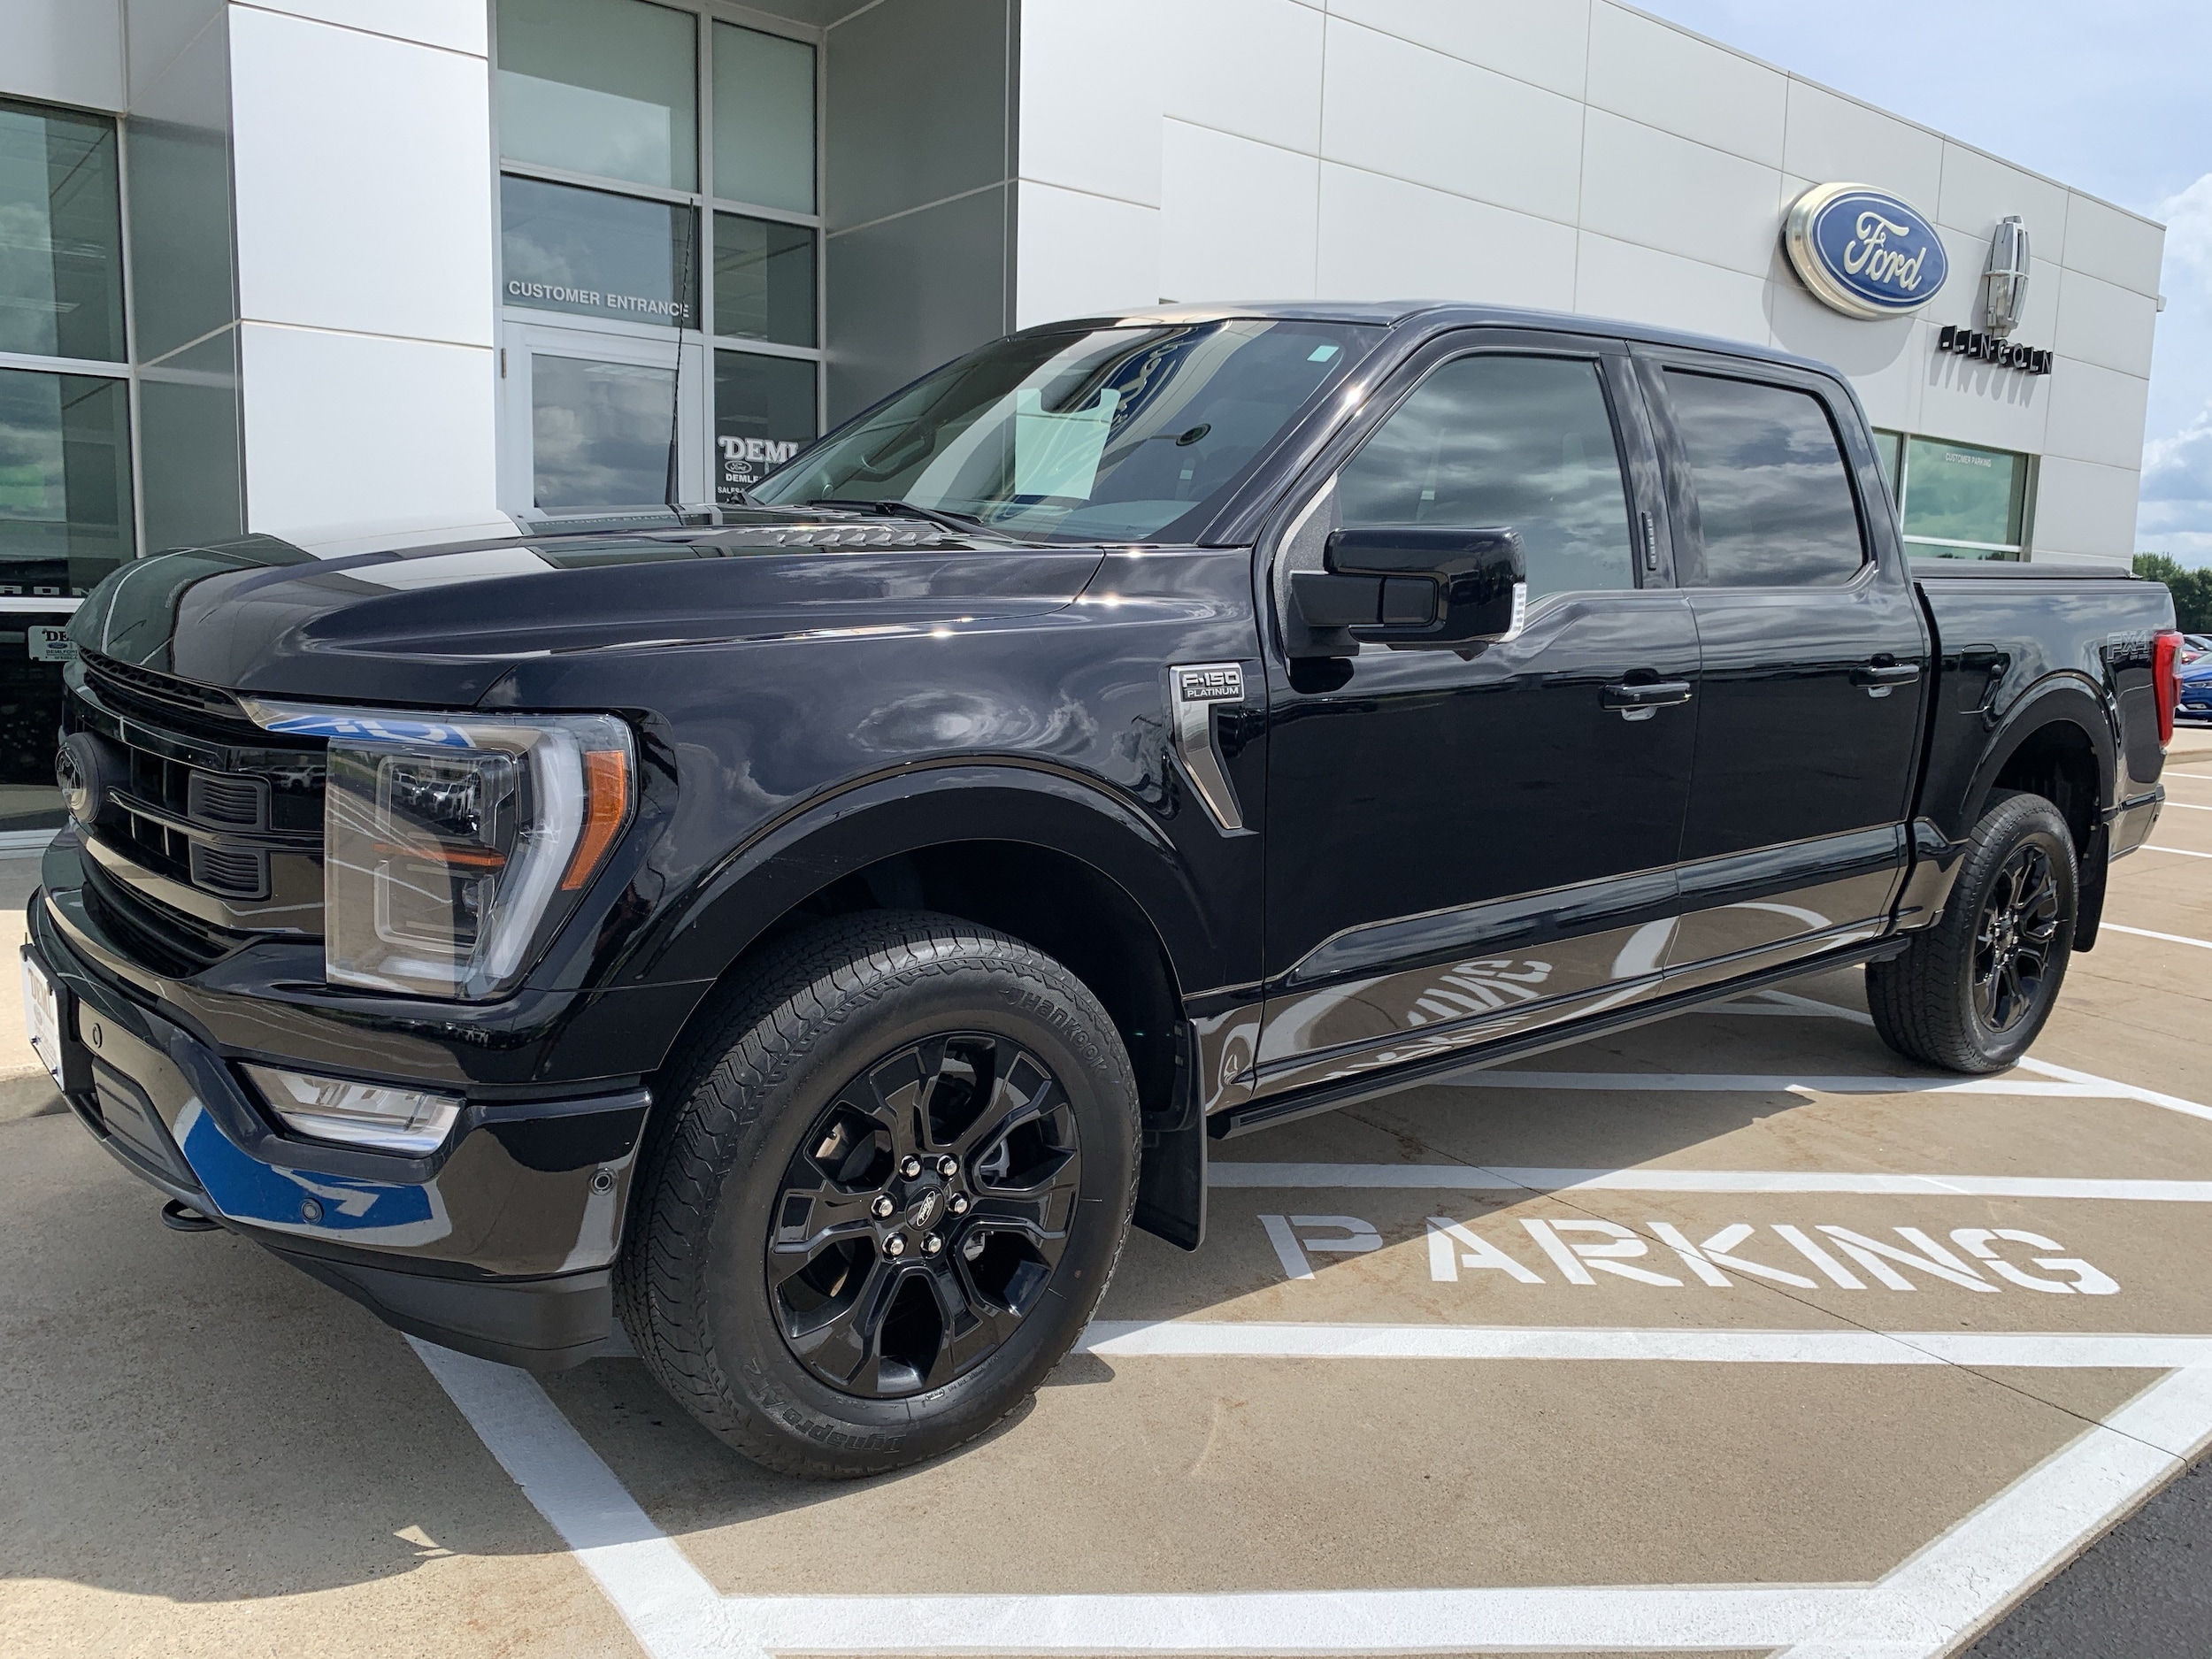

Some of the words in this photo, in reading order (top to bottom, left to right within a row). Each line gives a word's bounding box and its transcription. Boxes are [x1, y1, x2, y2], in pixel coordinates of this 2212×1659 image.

[1843, 211, 1927, 292] Ford
[508, 280, 601, 306] CUSTOMER
[606, 294, 690, 319] ENTRANCE
[1941, 325, 2054, 375] LINCOLN
[1946, 452, 1971, 465] CUSTOMER
[1970, 457, 1992, 468] PARKING
[2106, 629, 2150, 664] FX4
[1181, 671, 1240, 688] F-150
[1187, 687, 1240, 698] PLATINUM
[1256, 1214, 2121, 1296] PARKING
